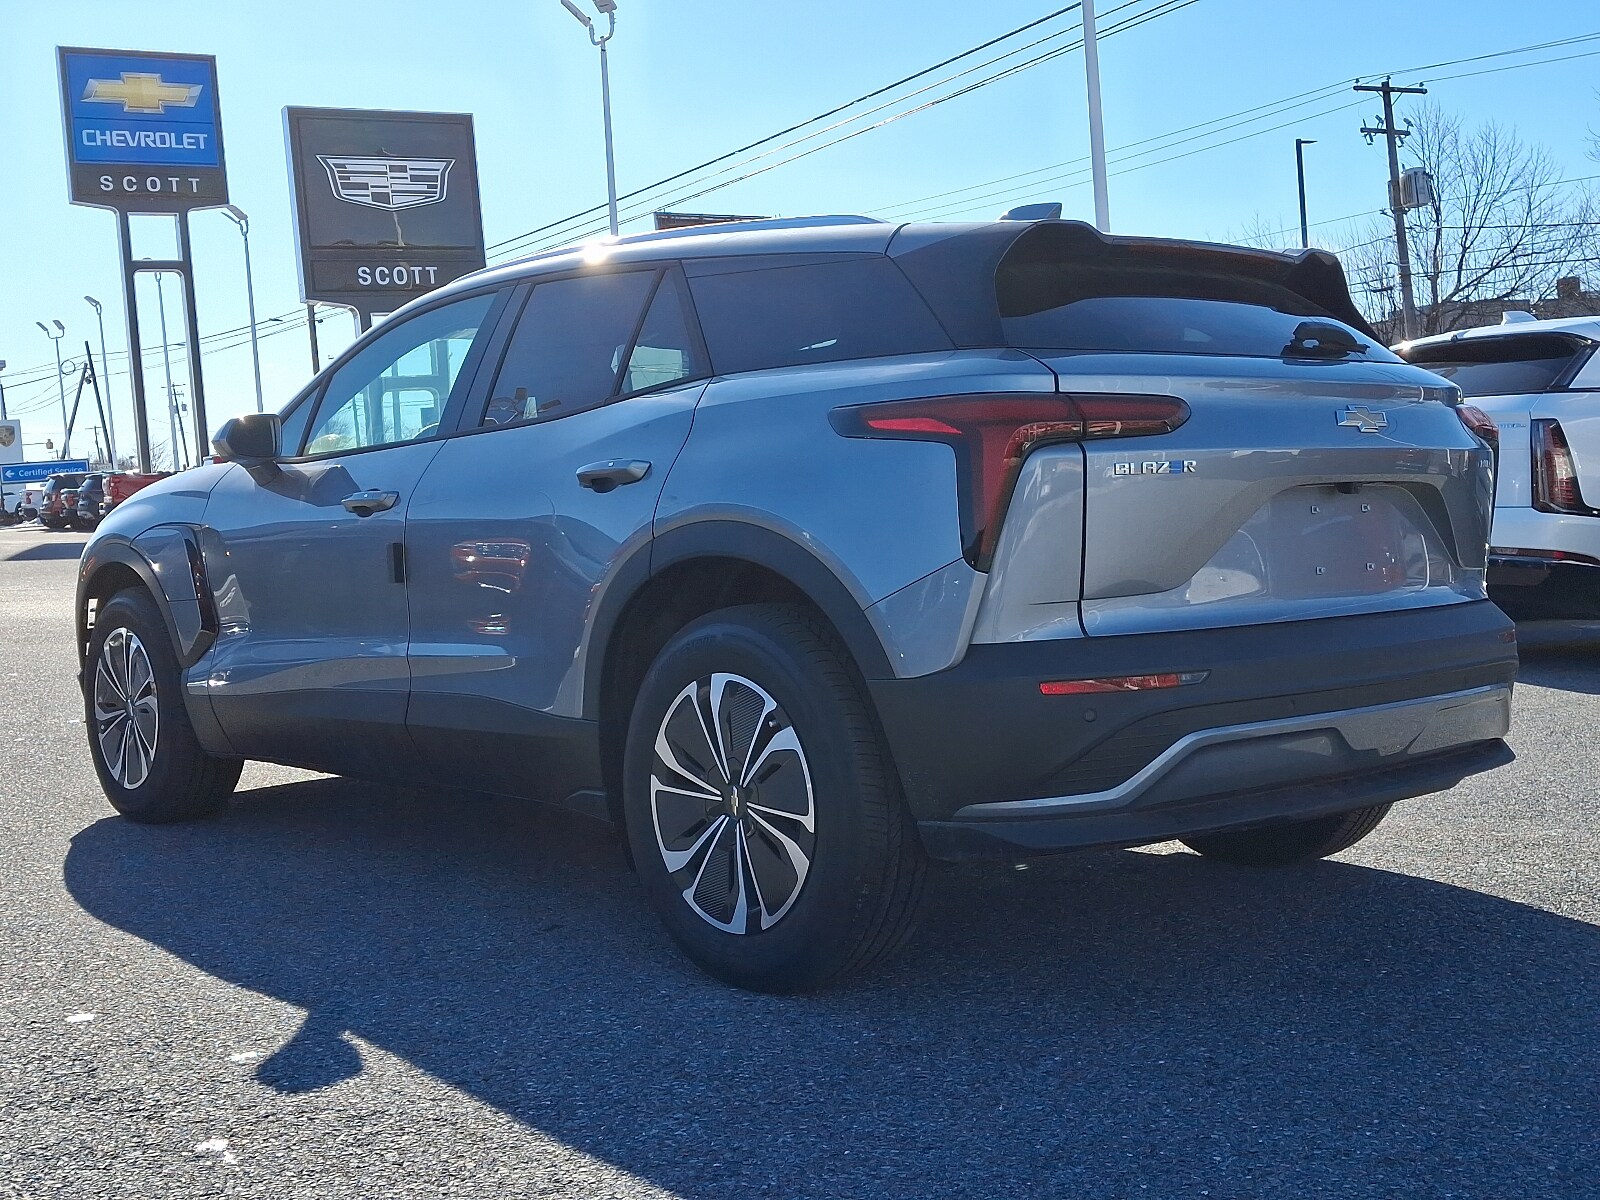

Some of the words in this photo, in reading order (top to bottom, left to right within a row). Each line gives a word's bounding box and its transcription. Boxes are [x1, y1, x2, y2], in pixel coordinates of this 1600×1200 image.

[82, 129, 208, 150] CHEVROLET
[99, 175, 200, 193] SCOTT
[357, 266, 438, 285] SCOTT
[18, 468, 53, 477] Certified
